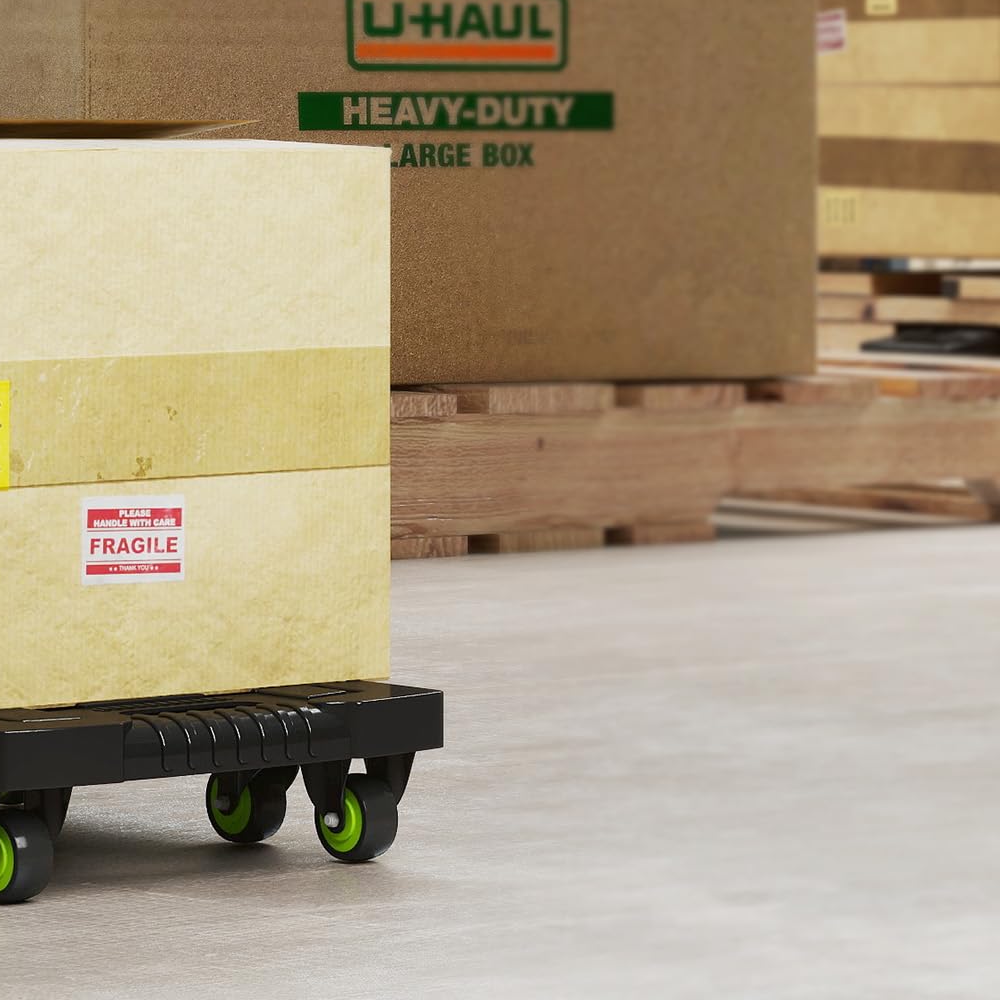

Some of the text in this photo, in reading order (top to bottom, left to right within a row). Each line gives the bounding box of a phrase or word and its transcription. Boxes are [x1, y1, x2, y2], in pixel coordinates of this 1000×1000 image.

[342, 96, 574, 126] HEAVY-DUTY
[482, 143, 534, 167] BOX
[93, 517, 177, 528] HANDLE WITH CARE
[119, 509, 151, 518] PLEASE
[90, 536, 179, 555] FRAGILE
